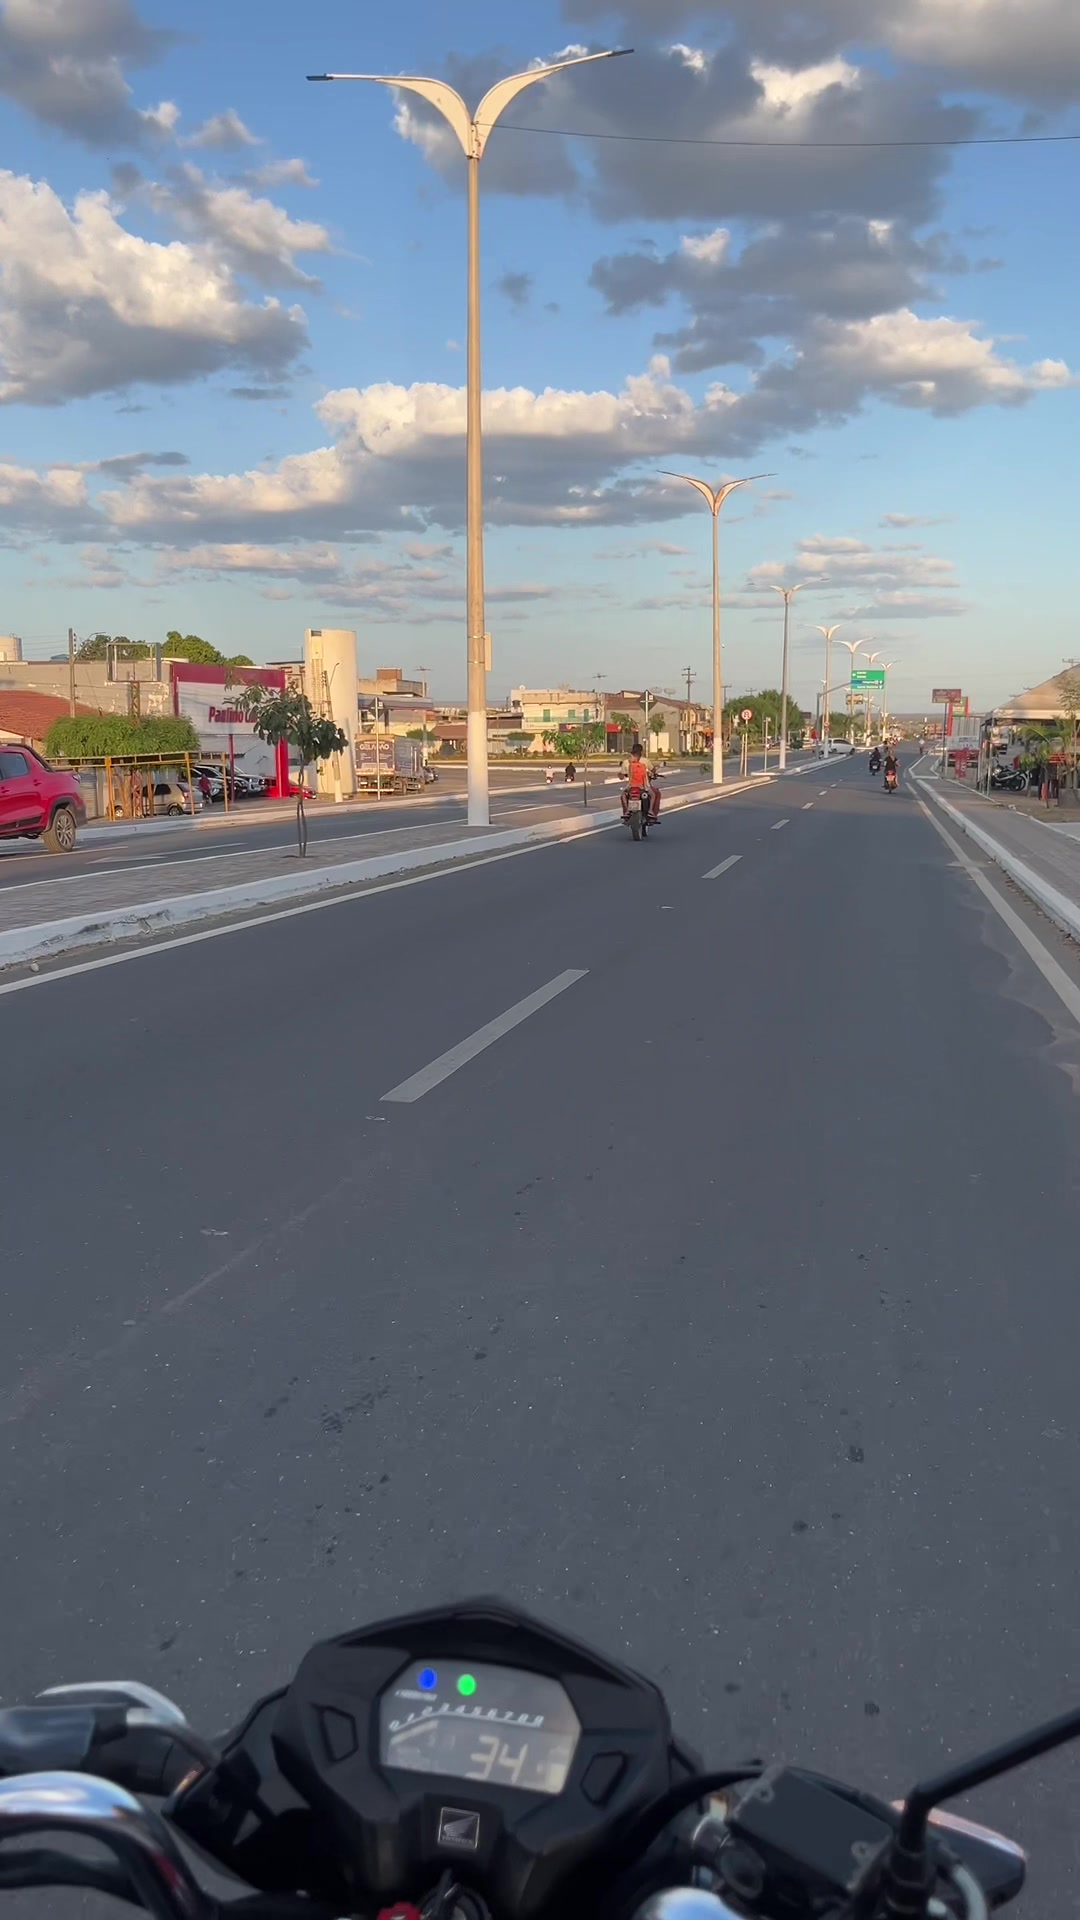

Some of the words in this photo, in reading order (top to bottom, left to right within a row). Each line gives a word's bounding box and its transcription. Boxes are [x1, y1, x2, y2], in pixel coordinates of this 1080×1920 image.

[389, 1719, 400, 1732] 0
[406, 1713, 415, 1722] 1
[421, 1705, 433, 1716] 2
[438, 1702, 450, 1712] 3
[454, 1704, 466, 1714] 4
[471, 1705, 483, 1716] 5
[503, 1710, 514, 1720] 7
[465, 1734, 528, 1784] 34
